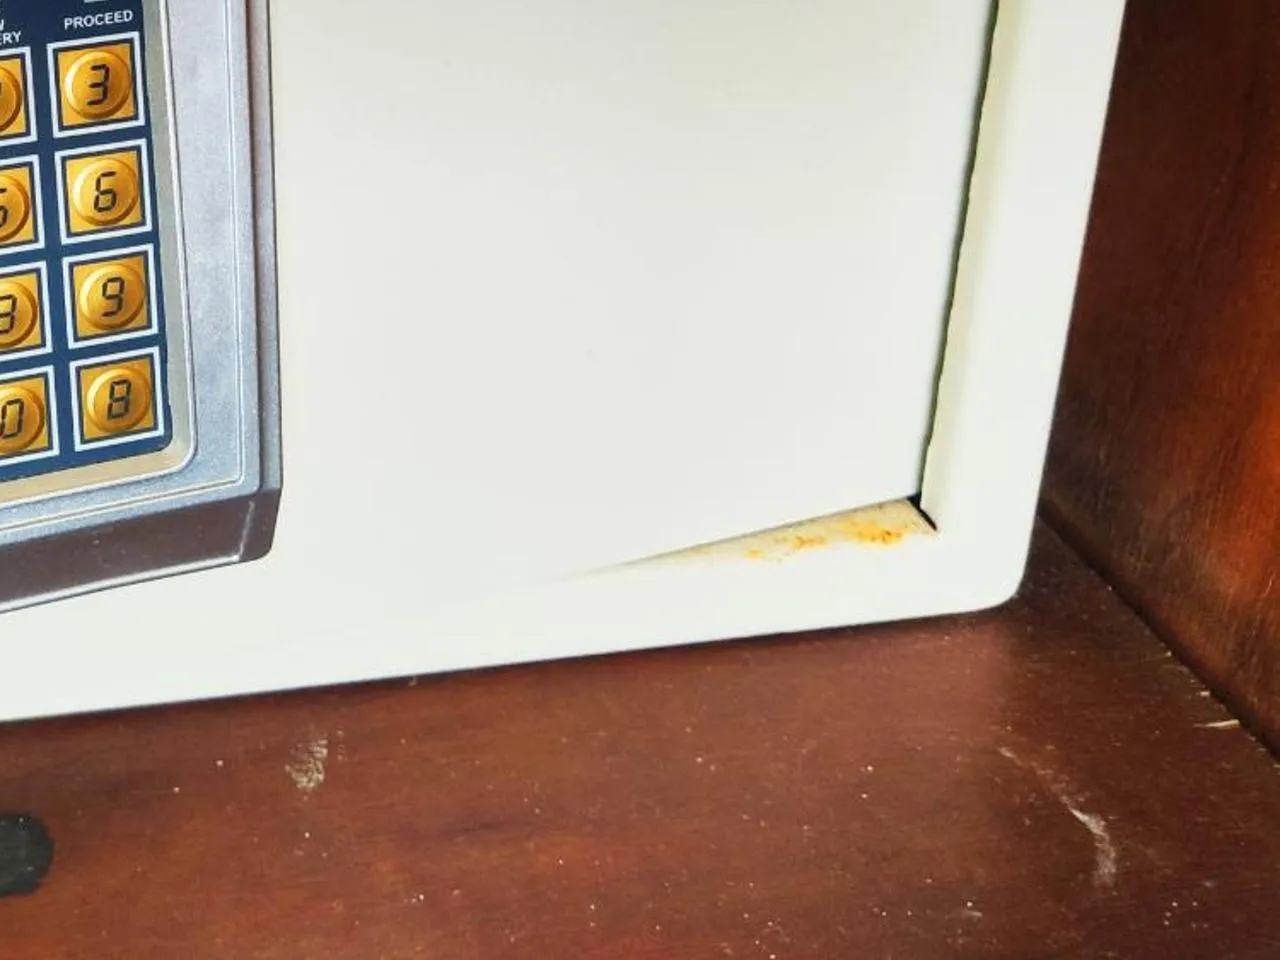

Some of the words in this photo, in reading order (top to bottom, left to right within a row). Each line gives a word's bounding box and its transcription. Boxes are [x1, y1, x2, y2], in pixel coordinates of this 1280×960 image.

[64, 9, 133, 30] PROCEED
[87, 63, 110, 106] 3
[93, 171, 117, 213] 6
[101, 276, 125, 317] 9
[0, 398, 25, 439] 0
